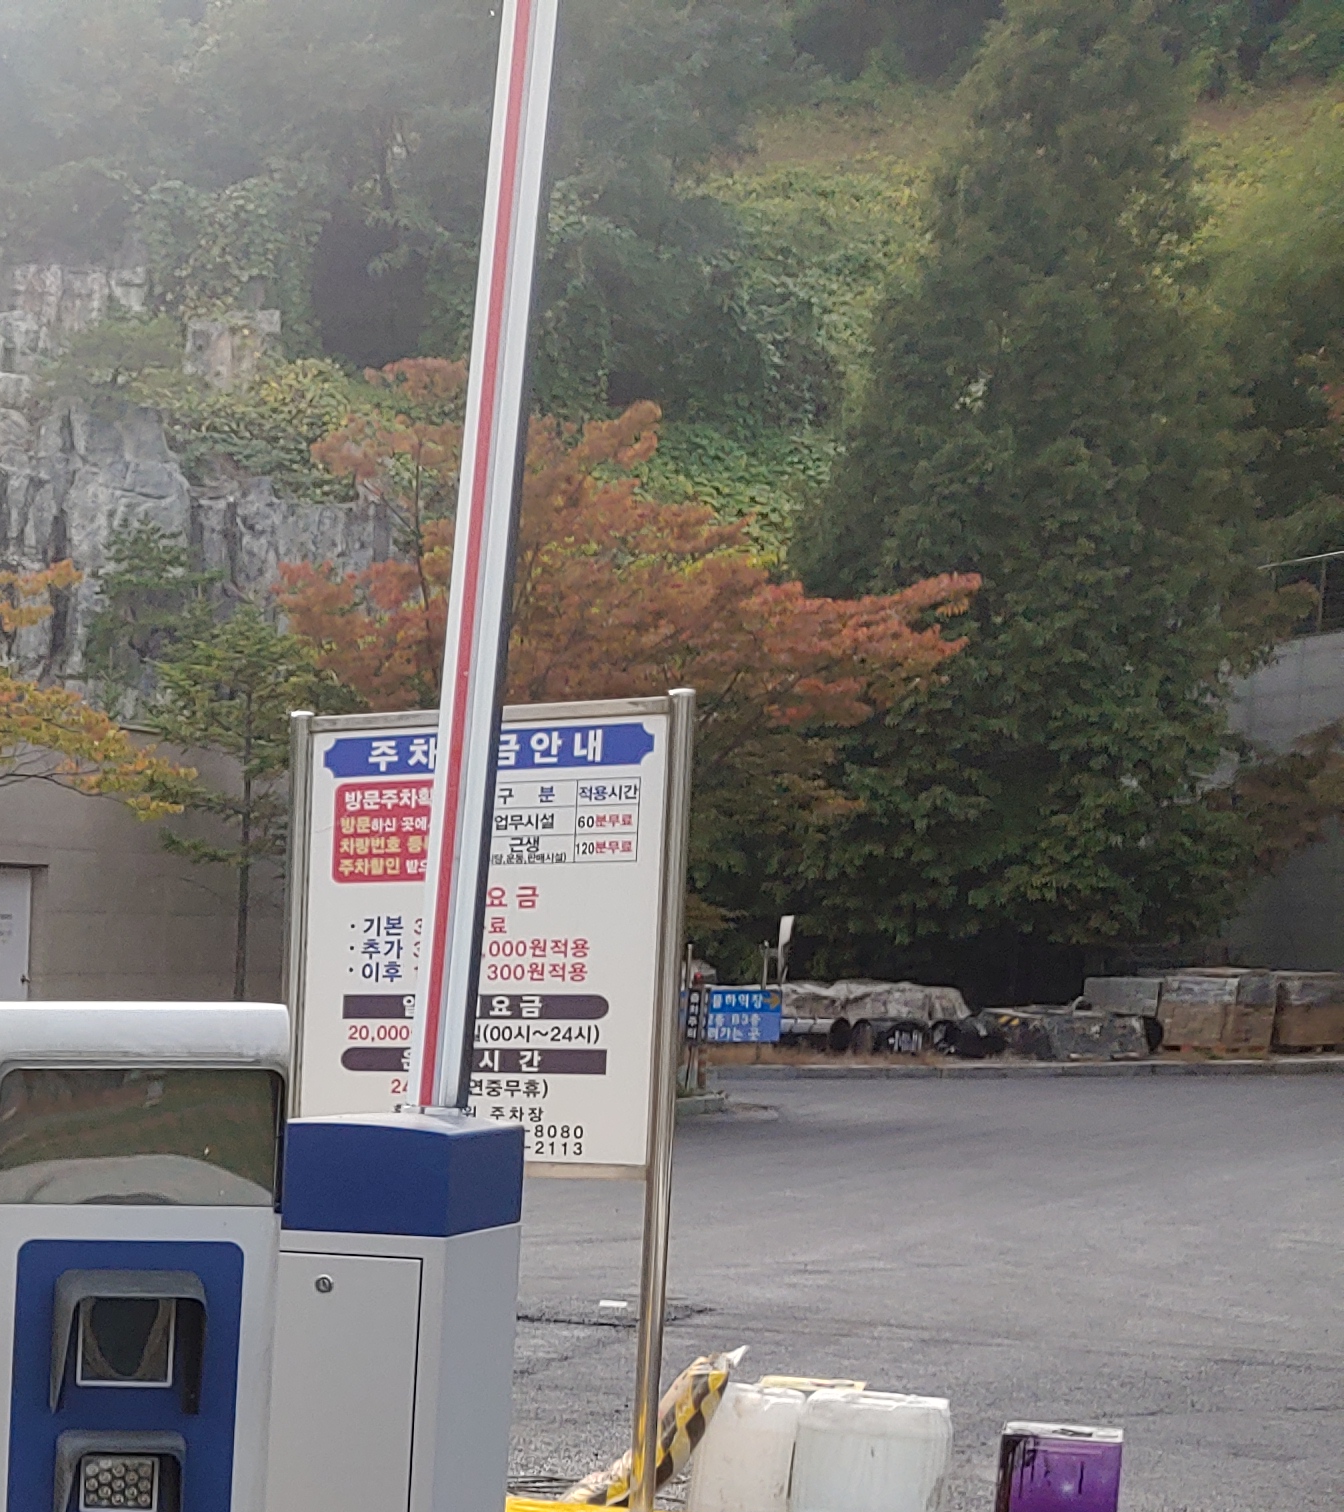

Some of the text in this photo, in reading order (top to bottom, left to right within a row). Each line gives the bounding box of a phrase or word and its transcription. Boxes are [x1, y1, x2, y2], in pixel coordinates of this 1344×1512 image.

[579, 783, 638, 802] 적용시간
[401, 816, 431, 832] 곳에
[494, 812, 555, 831] 업무시설
[509, 835, 540, 853] 근생
[363, 915, 404, 937] 기본
[361, 938, 403, 960] 추가
[361, 961, 588, 983] 이후 300원적용
[348, 1025, 413, 1042] 20,000
[490, 1106, 545, 1123] 주차장
